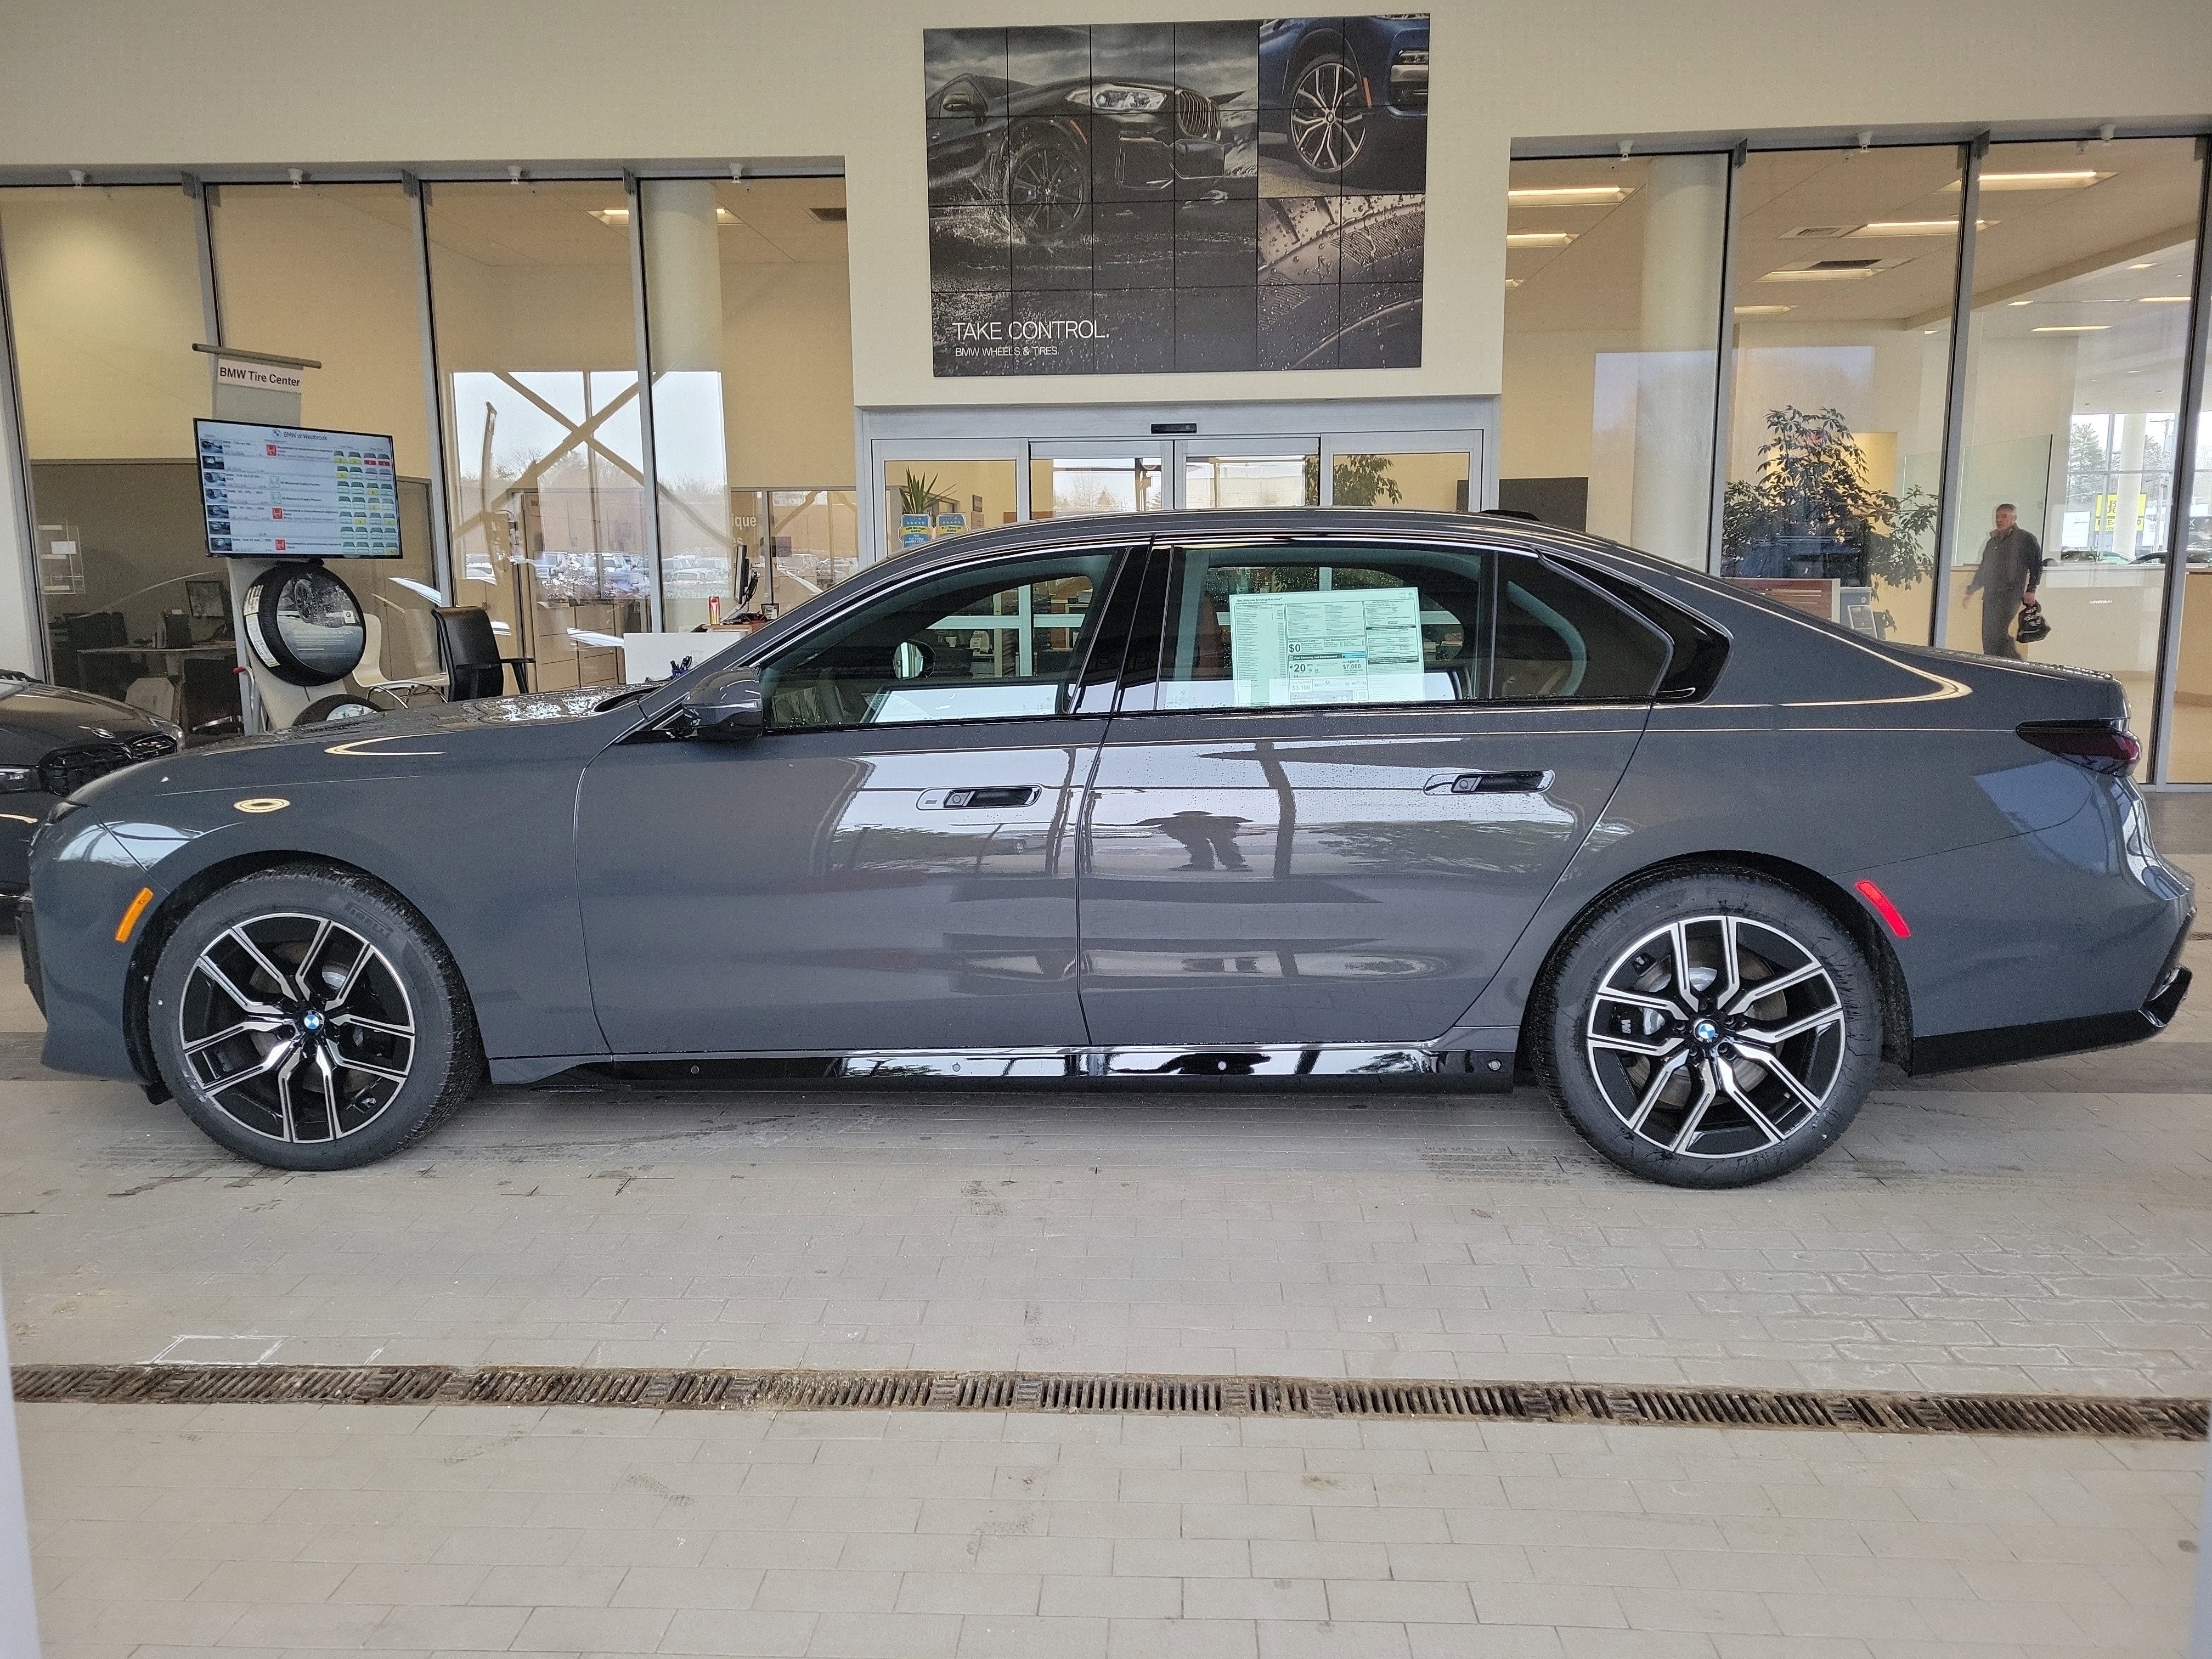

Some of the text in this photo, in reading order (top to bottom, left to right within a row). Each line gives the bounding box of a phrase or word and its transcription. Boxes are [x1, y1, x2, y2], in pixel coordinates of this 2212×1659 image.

[952, 320, 1110, 340] TAKE CONTROL.
[955, 346, 1059, 357] BMW WHEELS & TIRES.
[219, 366, 301, 387] BMW Tire Center
[1289, 644, 1301, 652] $0
[1294, 664, 1306, 672] 20
